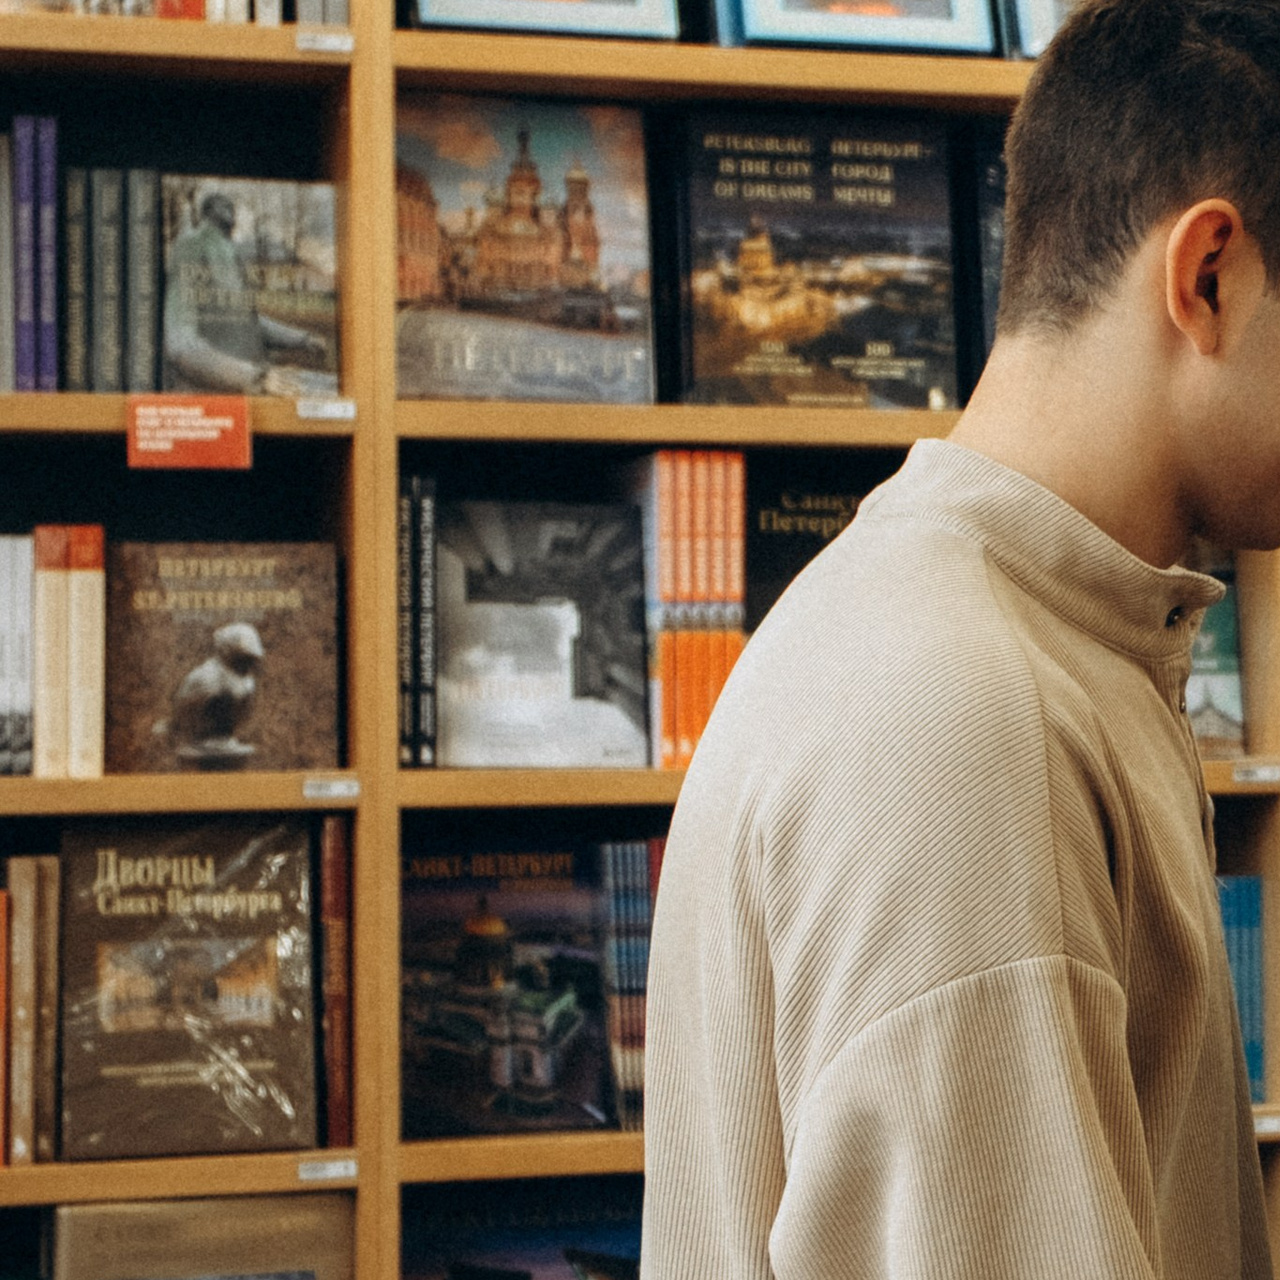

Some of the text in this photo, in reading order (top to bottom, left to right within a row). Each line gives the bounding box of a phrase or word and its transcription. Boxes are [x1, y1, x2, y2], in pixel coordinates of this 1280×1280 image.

[703, 135, 812, 155] PETERSBURG
[739, 158, 770, 177] THE
[774, 160, 813, 178] CITY
[831, 163, 894, 184] ГОРОД
[713, 180, 815, 202] OF DREAMS
[157, 556, 278, 578] ПЕТЕРБУРГ
